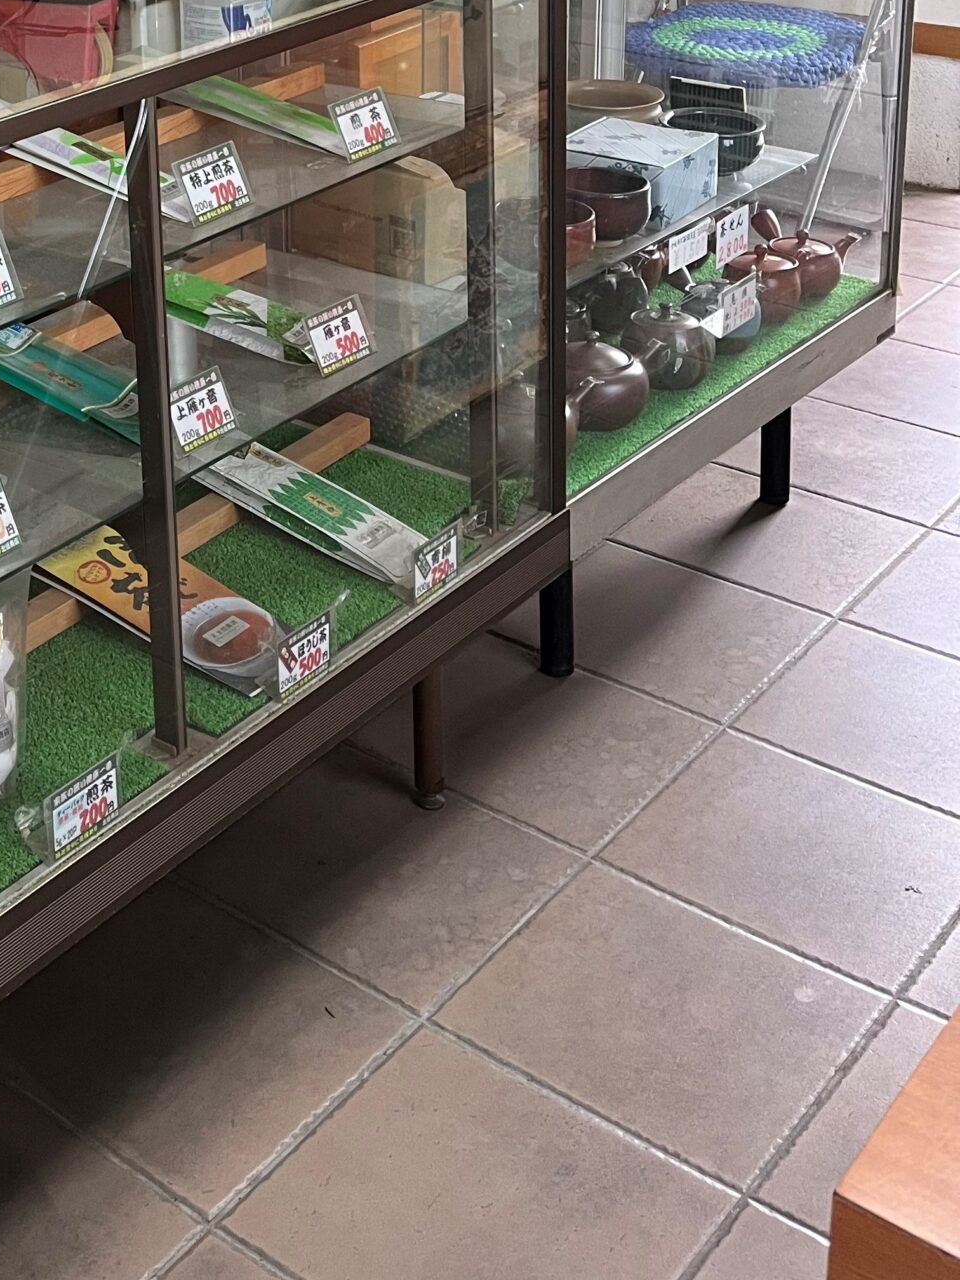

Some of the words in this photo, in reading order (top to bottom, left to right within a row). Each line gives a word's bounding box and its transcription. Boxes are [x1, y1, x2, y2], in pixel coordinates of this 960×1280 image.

[189, 160, 235, 189] 特上煎茶
[297, 627, 328, 659] ほうじ茶
[86, 774, 114, 806] 煎茶
